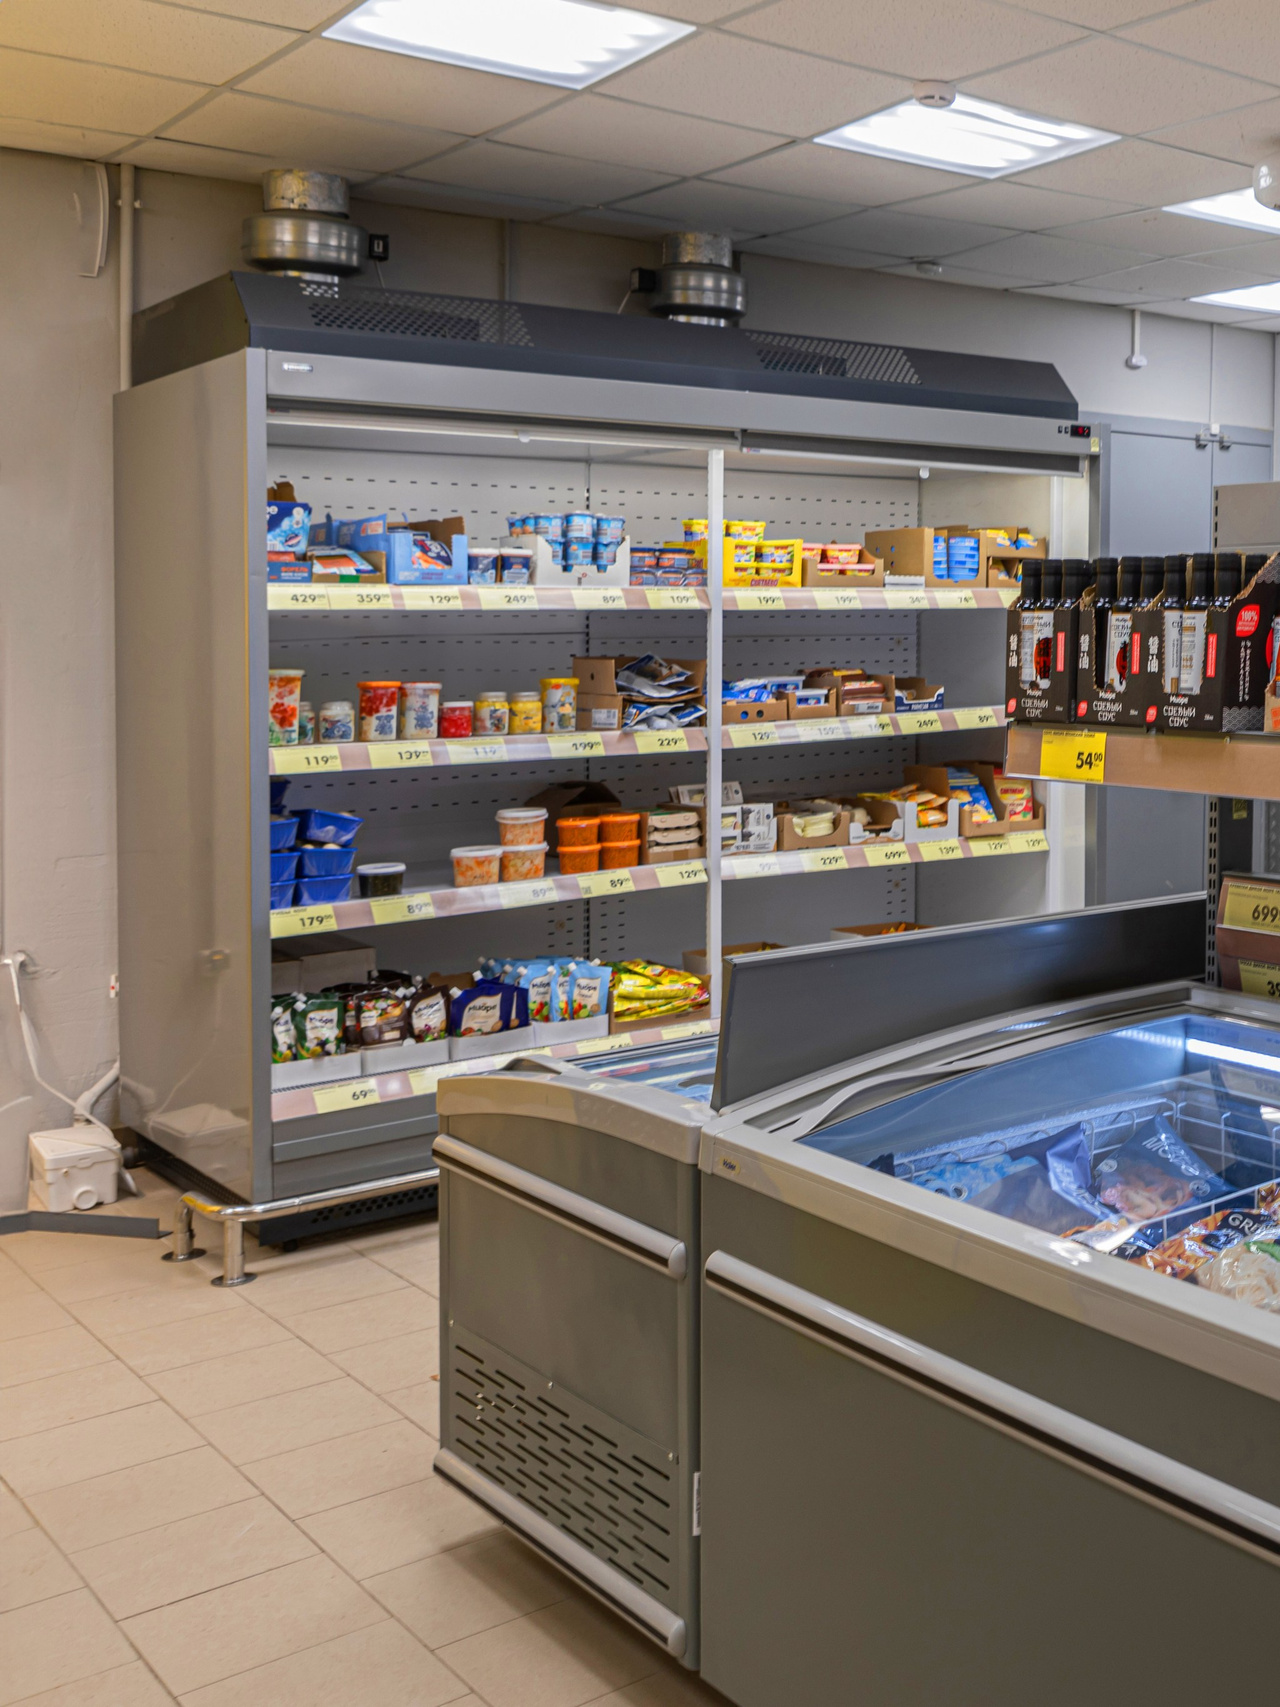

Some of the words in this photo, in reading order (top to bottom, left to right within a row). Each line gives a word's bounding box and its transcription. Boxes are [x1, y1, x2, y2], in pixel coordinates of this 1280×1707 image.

[1241, 611, 1257, 621] 100%
[1021, 698, 1048, 708] СОЕВЫЙ
[1093, 701, 1122, 712] СОЕВЫЙ
[1026, 708, 1042, 718] СОУС
[1163, 705, 1196, 717] СОЕВЫЙ
[1098, 711, 1116, 722] СОУС
[1169, 717, 1188, 727] СОУС
